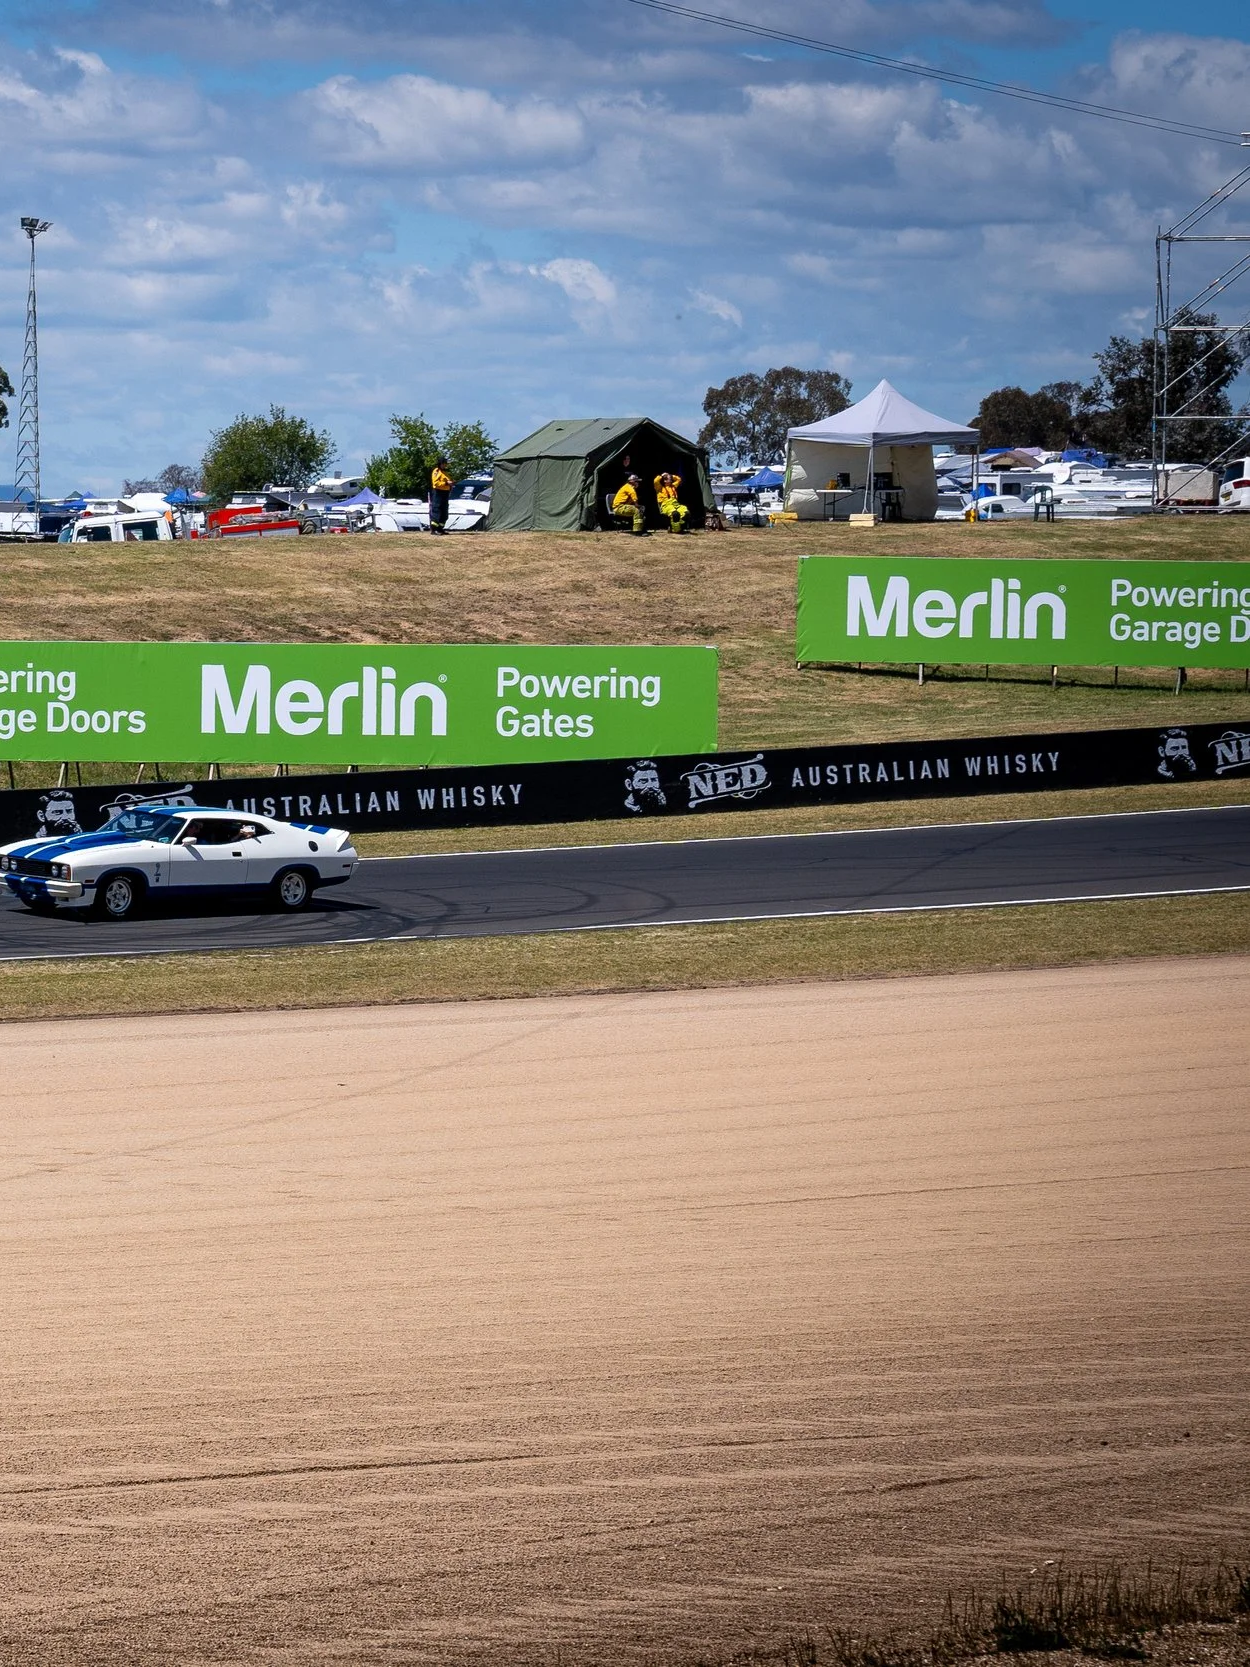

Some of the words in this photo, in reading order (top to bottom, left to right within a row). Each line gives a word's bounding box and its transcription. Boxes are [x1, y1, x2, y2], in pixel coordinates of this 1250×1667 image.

[847, 576, 1066, 639] Merlin
[1111, 579, 1250, 615] Powering
[1110, 613, 1221, 649] Garage
[201, 664, 447, 736] Merlin
[497, 667, 660, 707] Powering
[47, 702, 146, 734] Doors
[496, 706, 594, 738] Gates
[687, 764, 768, 799] NED
[792, 759, 949, 787] AUSTRALIAN
[965, 752, 1058, 776] WHISKY
[417, 784, 521, 809] WHISKY
